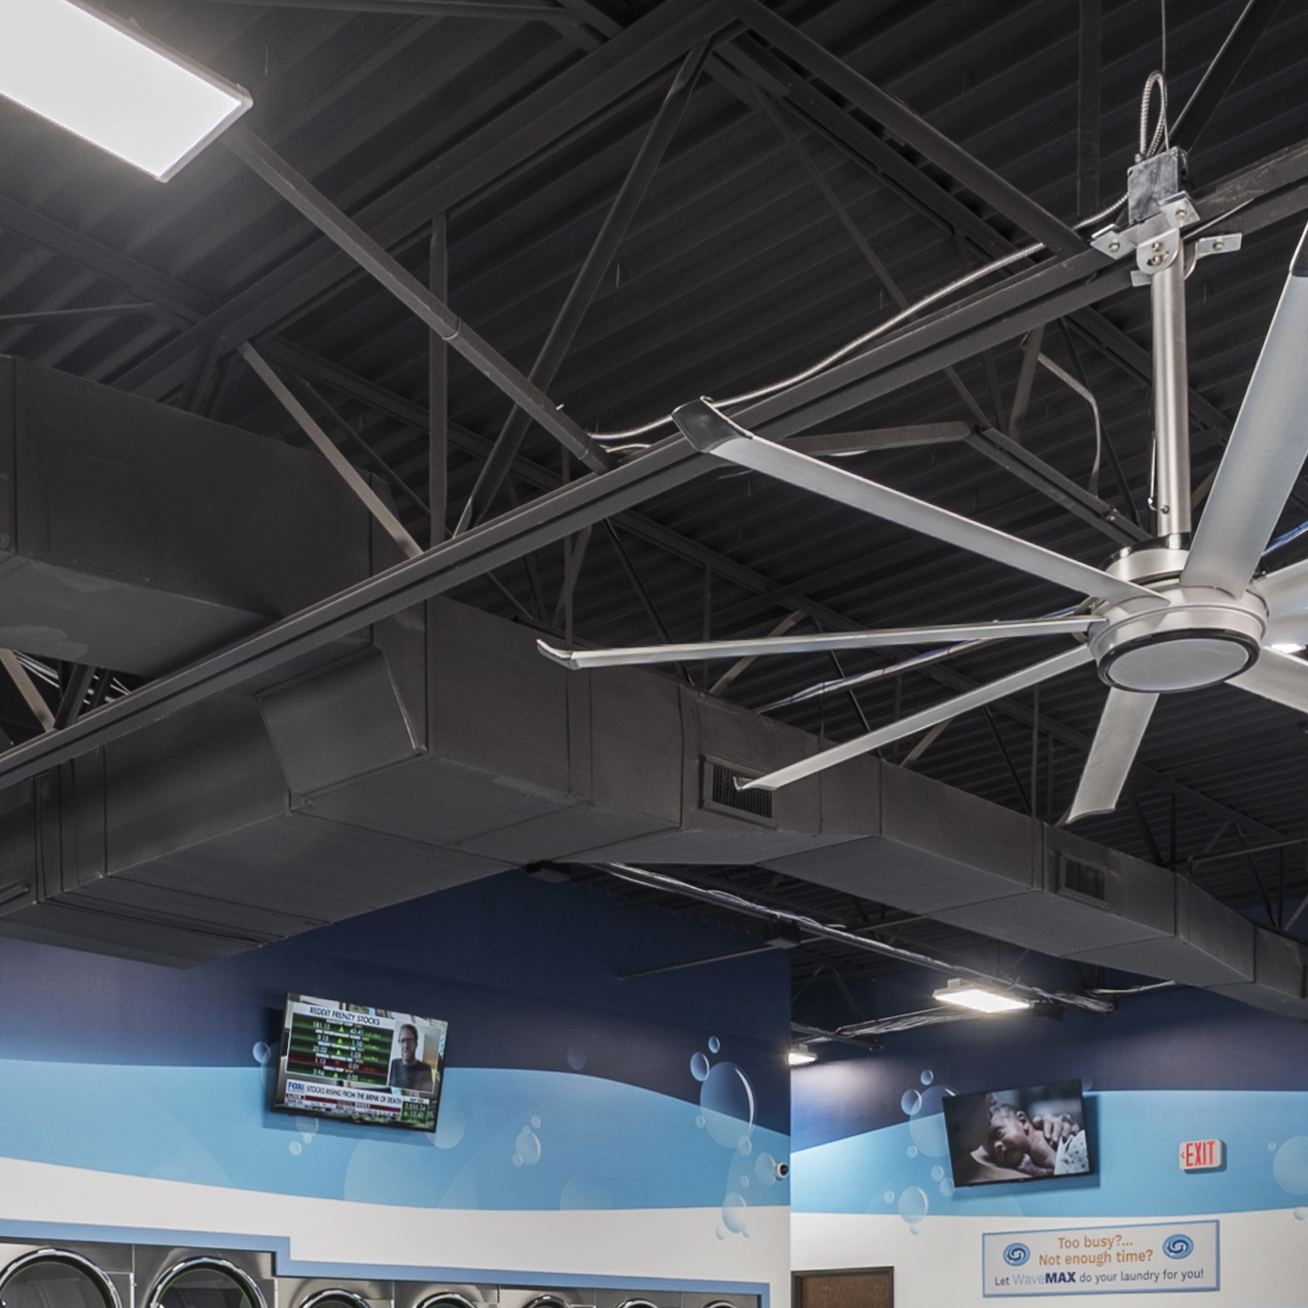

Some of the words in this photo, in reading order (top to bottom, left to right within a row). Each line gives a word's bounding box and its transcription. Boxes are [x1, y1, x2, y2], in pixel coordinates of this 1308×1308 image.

[357, 1015, 380, 1025] STOCKS
[1186, 1141, 1215, 1167] EXIT
[1058, 1237, 1080, 1249] Too
[1039, 1254, 1061, 1266] Not
[1065, 1252, 1112, 1266] enough
[1116, 1249, 1153, 1263] time?
[995, 1276, 1010, 1286] Let
[1079, 1272, 1092, 1283] do
[1095, 1273, 1117, 1284] your
[1121, 1269, 1160, 1283] laundry
[1163, 1269, 1178, 1280] for
[1181, 1268, 1204, 1281] you!
